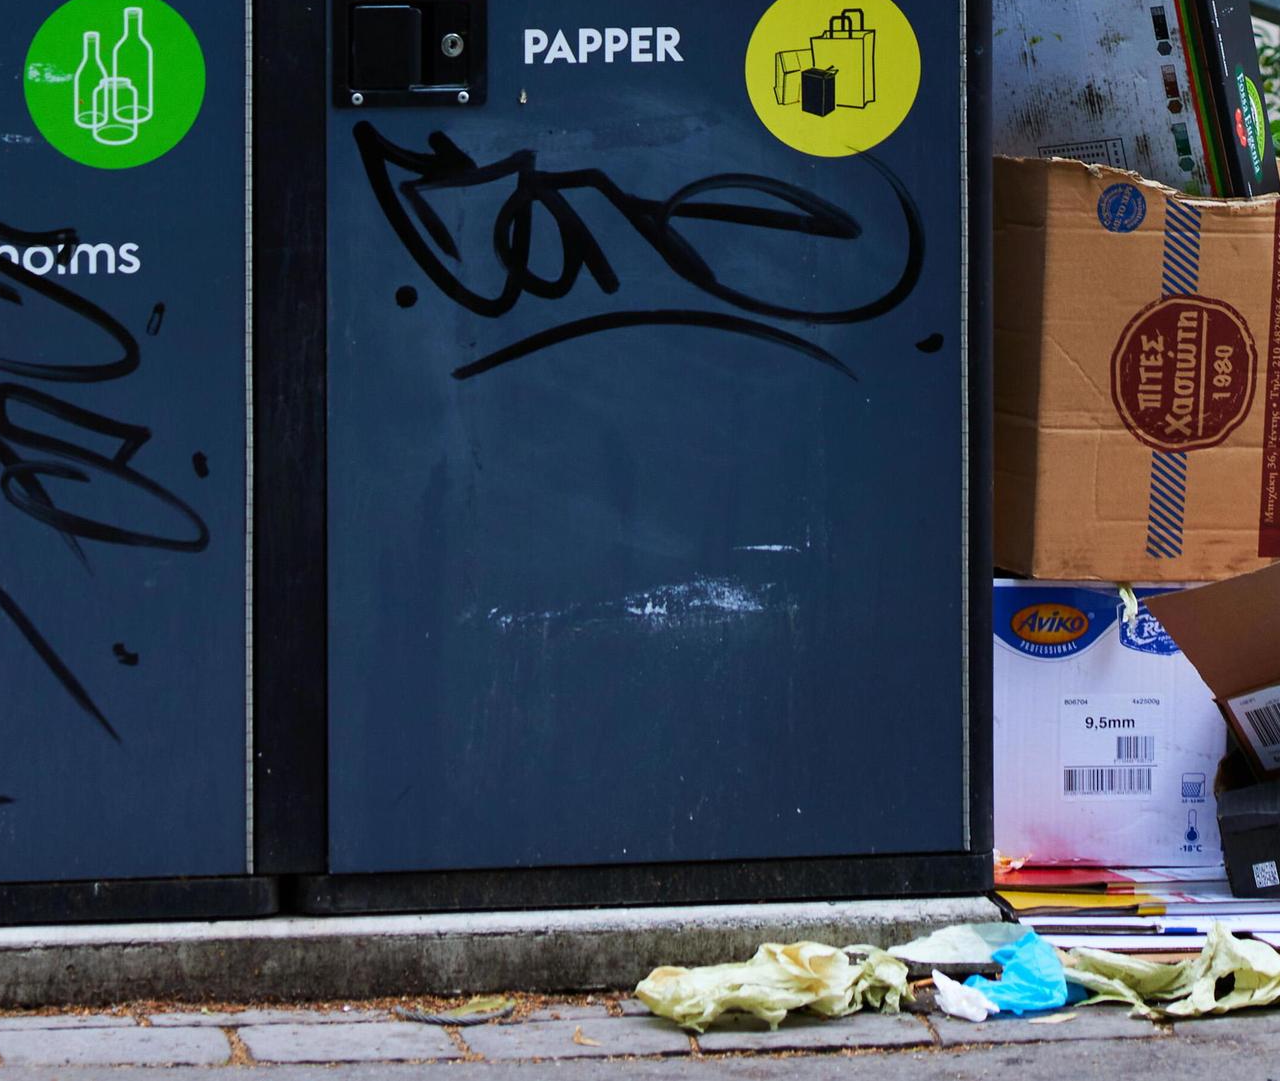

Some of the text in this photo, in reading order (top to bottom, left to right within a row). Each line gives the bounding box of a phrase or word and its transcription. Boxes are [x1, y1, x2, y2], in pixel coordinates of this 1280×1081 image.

[524, 26, 685, 65] PAPPER
[1272, 346, 1280, 366] 210
[1212, 344, 1234, 401] 1980
[1020, 639, 1078, 655] PROFESSIONAL
[1085, 716, 1136, 731] 9,5mm
